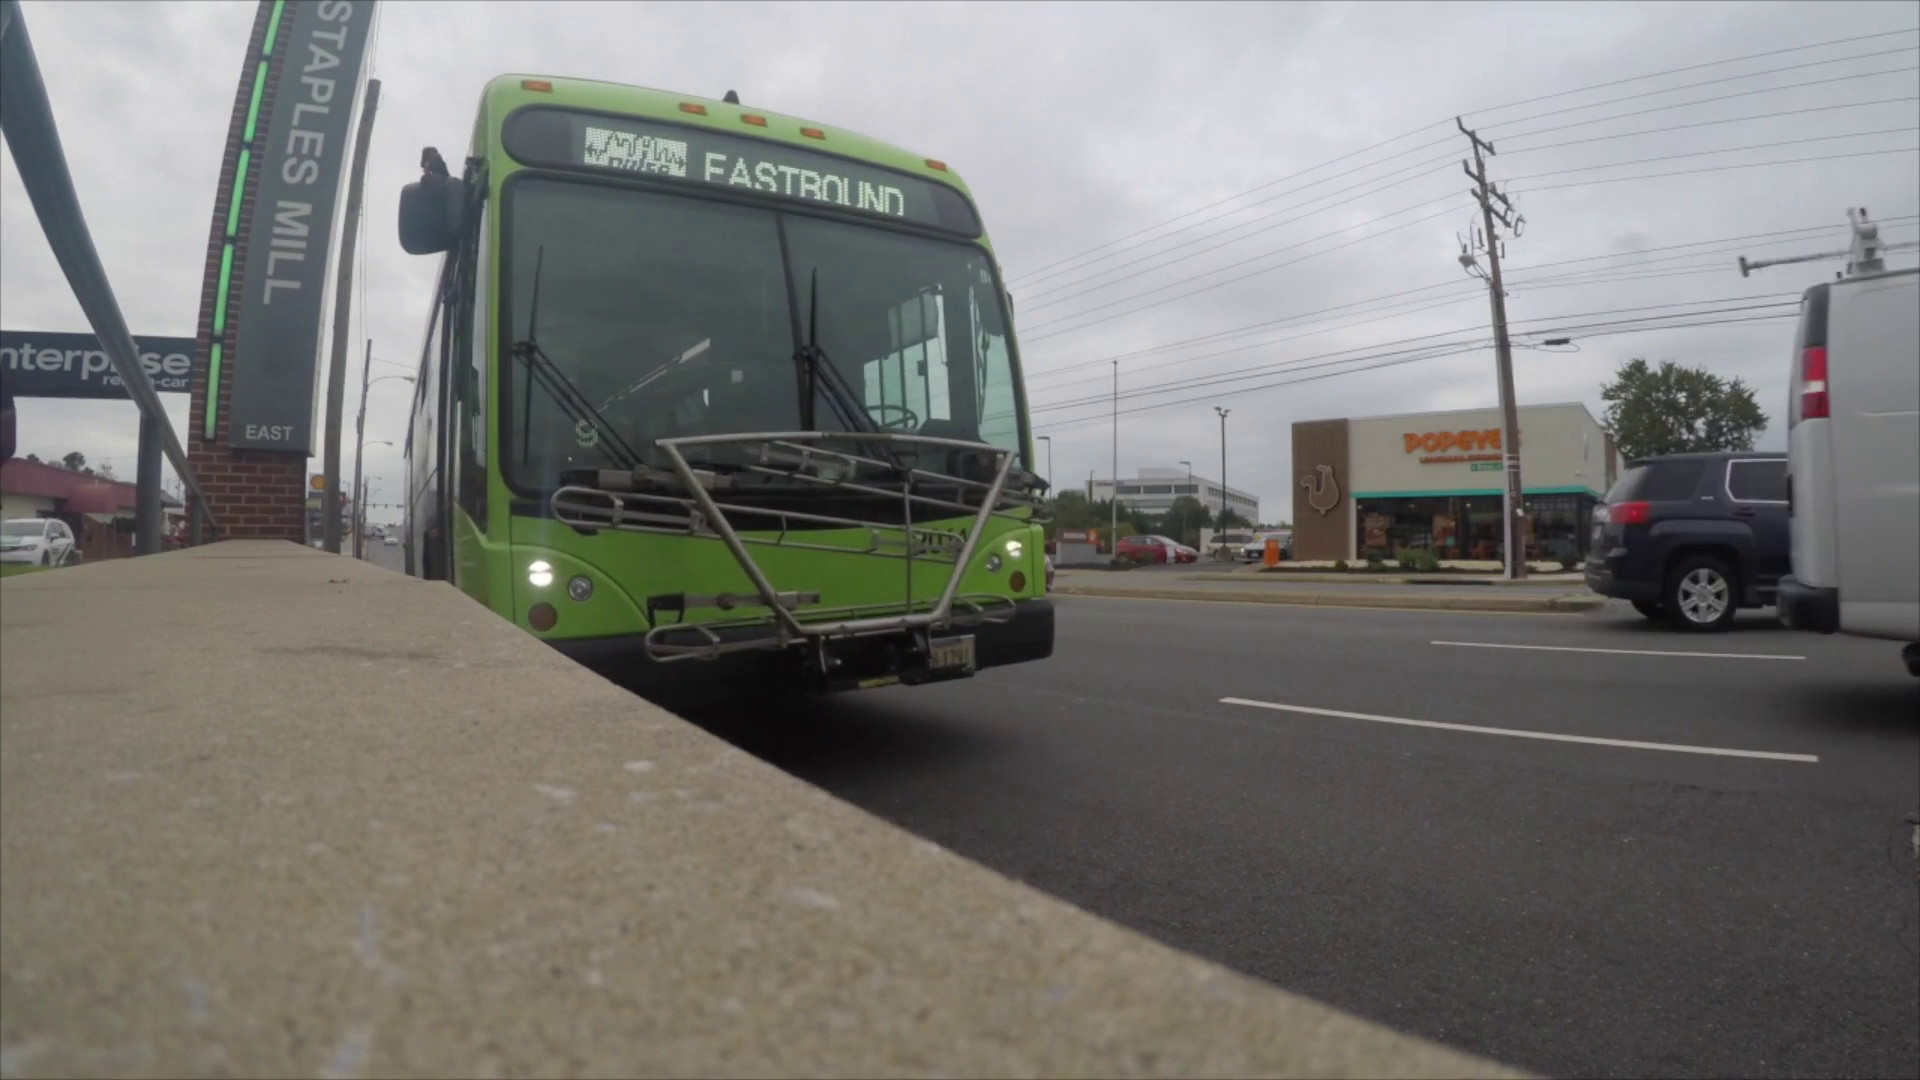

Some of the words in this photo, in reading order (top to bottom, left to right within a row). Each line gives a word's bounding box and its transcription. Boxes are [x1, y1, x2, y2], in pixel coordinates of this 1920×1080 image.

[282, 0, 351, 186] STAPLES
[263, 200, 313, 305] MILL
[0, 343, 192, 380] nterpse
[246, 424, 294, 441] EAST
[1403, 428, 1503, 453] POPEYE
